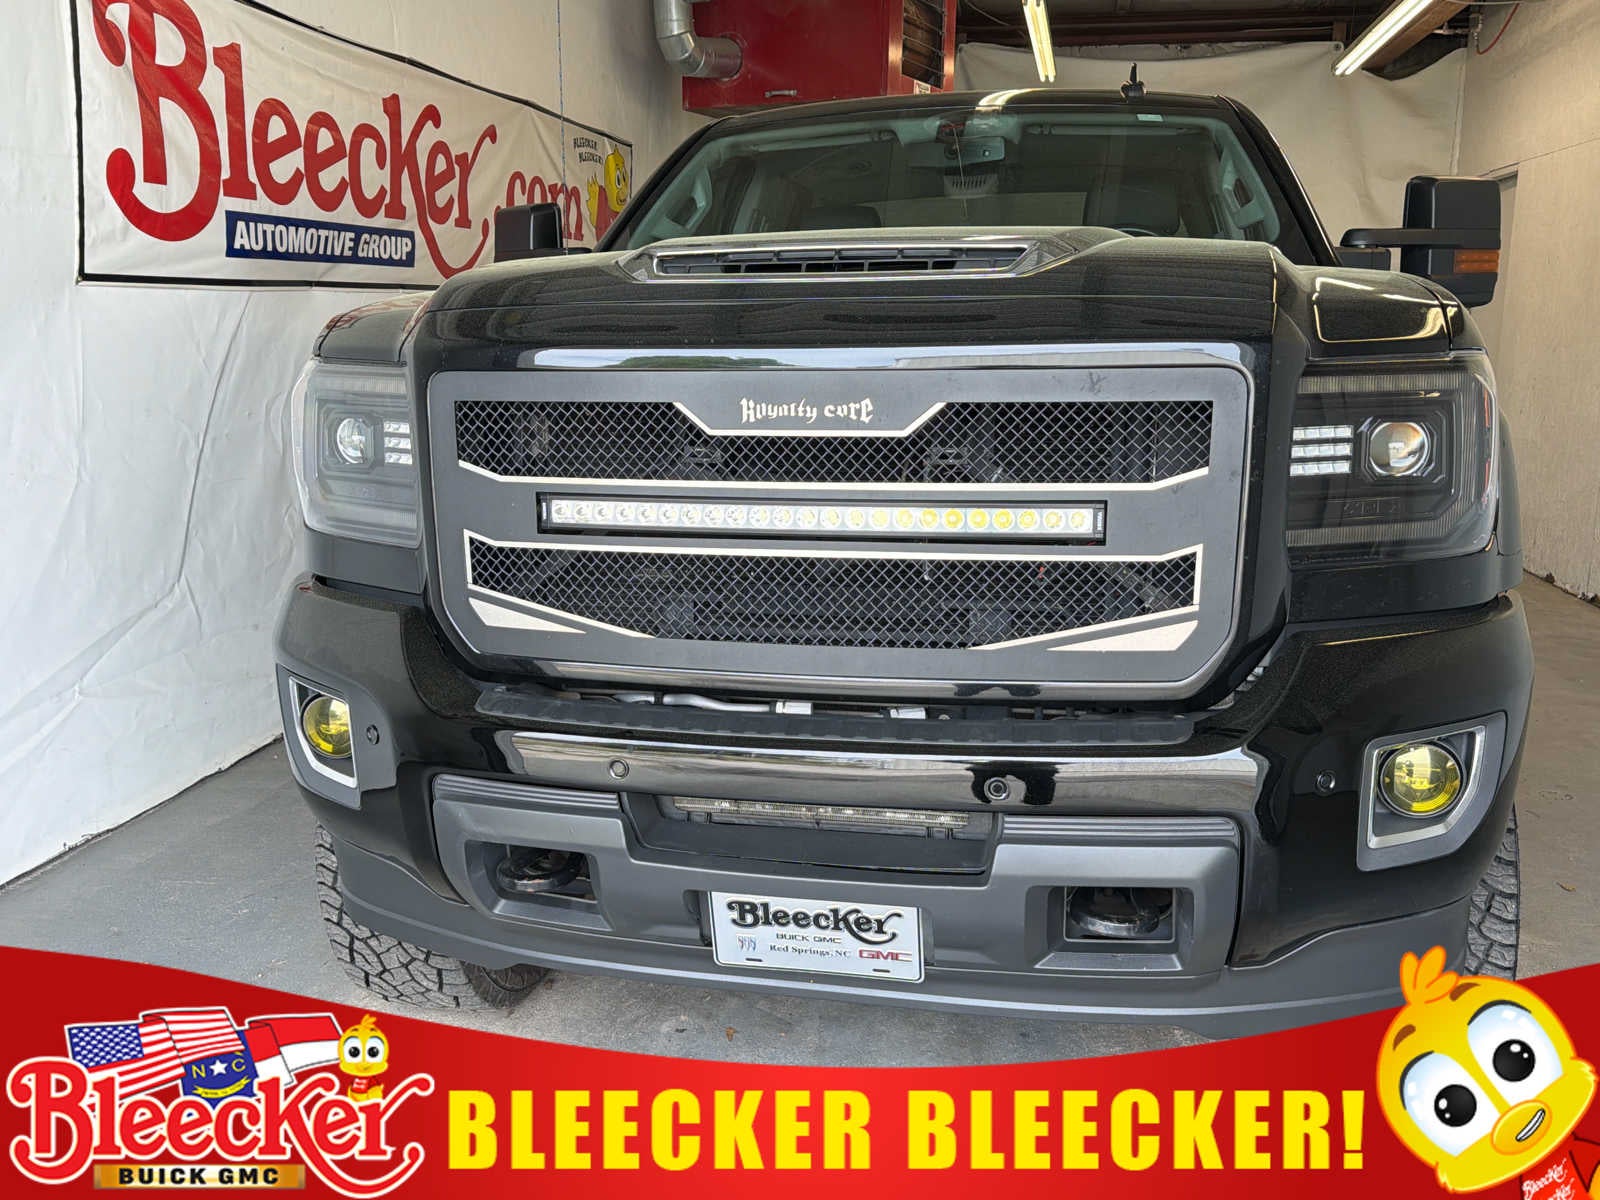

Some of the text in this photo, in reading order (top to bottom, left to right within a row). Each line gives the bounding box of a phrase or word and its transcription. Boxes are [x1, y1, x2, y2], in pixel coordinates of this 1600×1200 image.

[233, 220, 412, 261] AUTOMOTIVE GROUP
[727, 901, 903, 945] Bleecker
[776, 932, 842, 944] BUICK GMC
[769, 944, 851, 958] Red Springs, NC
[858, 949, 913, 962] GMC
